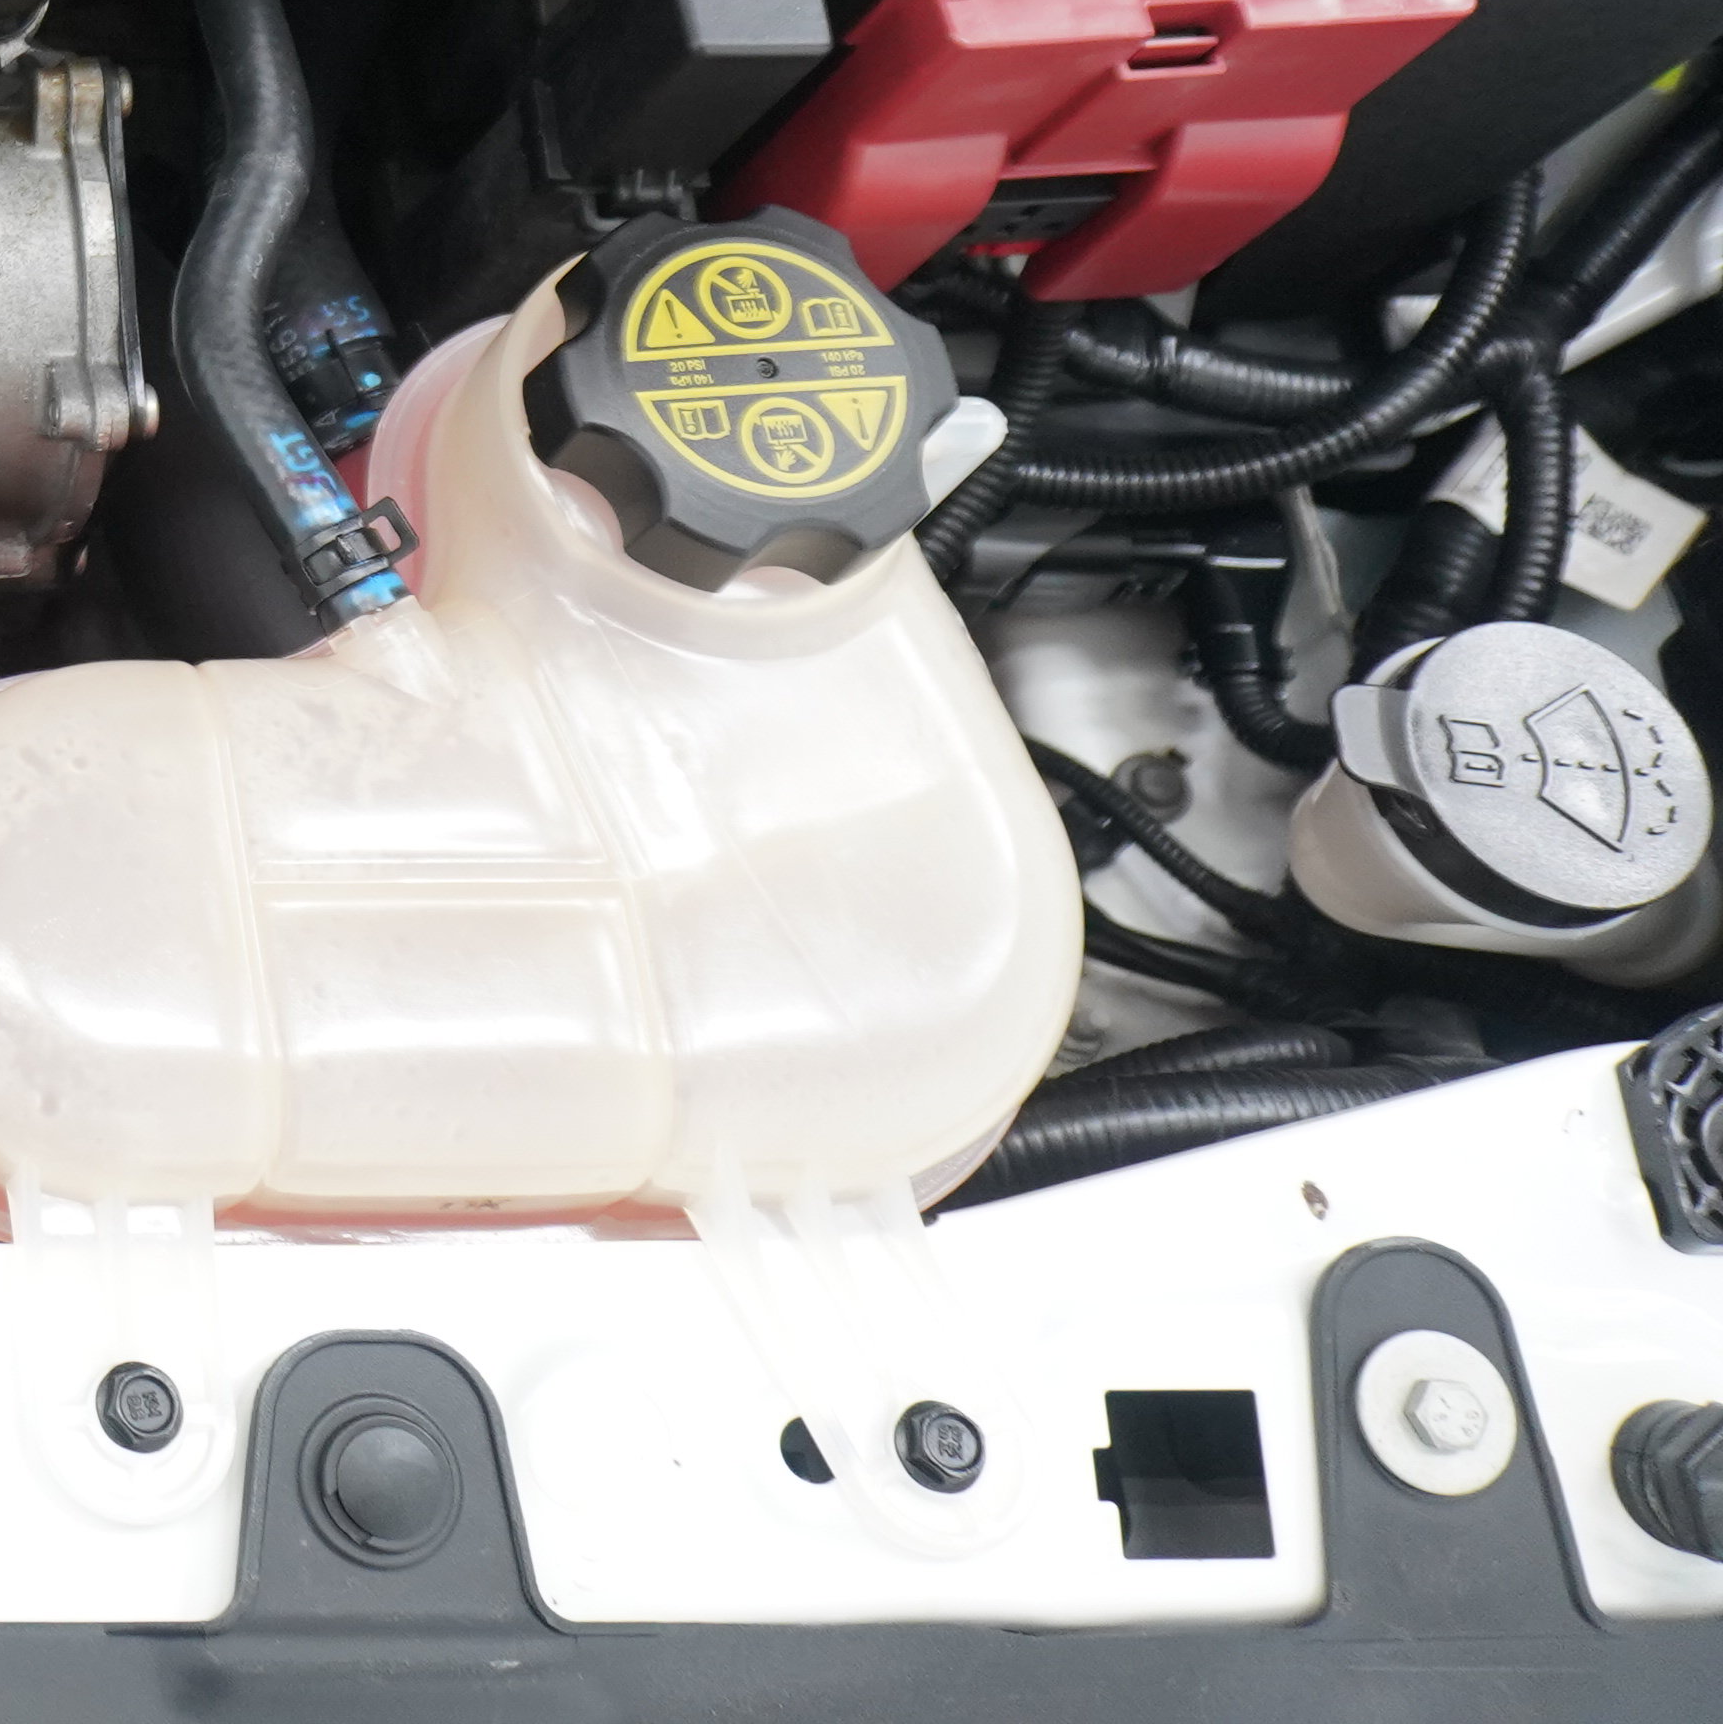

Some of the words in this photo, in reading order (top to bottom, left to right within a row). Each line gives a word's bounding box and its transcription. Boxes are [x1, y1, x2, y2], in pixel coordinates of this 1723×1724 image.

[821, 351, 844, 363] 140
[669, 360, 686, 373] 20
[688, 358, 707, 372] PSI
[830, 365, 849, 377] PSI
[850, 364, 866, 376] 20
